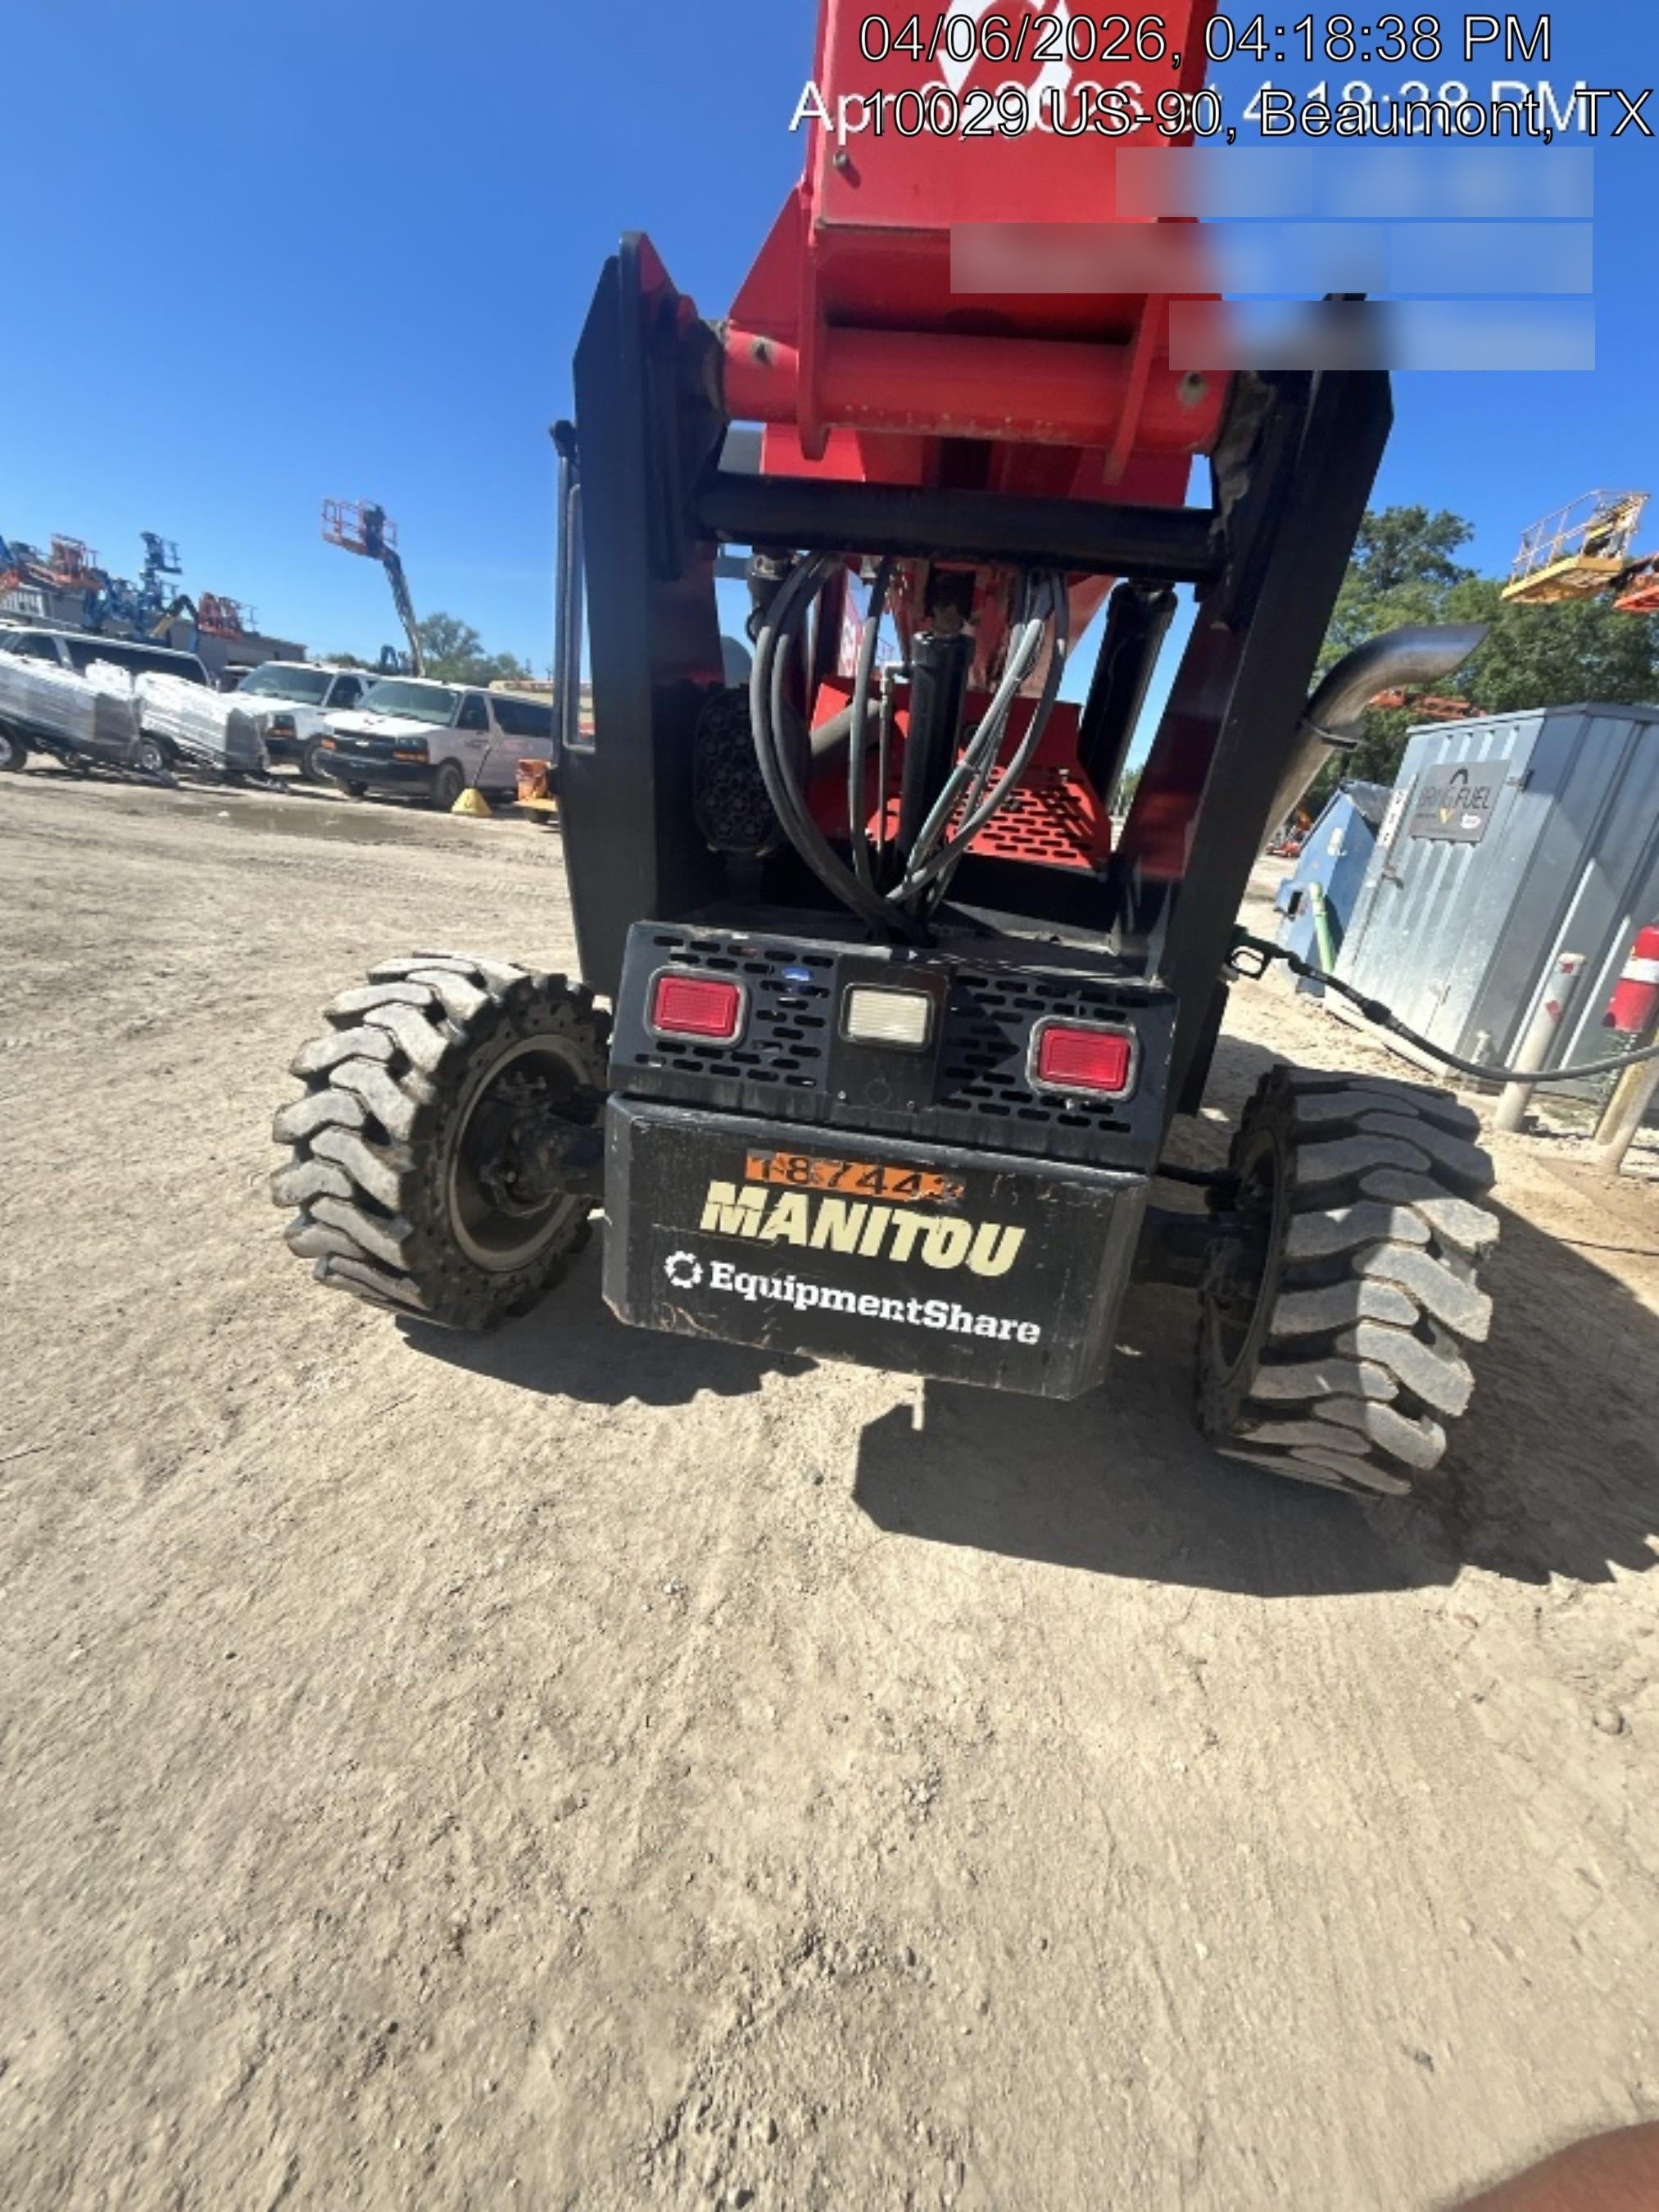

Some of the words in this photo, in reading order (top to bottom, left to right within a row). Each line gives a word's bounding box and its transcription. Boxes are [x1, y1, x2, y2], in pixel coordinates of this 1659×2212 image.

[1453, 786, 1491, 809] FUEL
[700, 1181, 1026, 1277] MANITOU
[709, 1260, 1040, 1344] EquipmentShare
